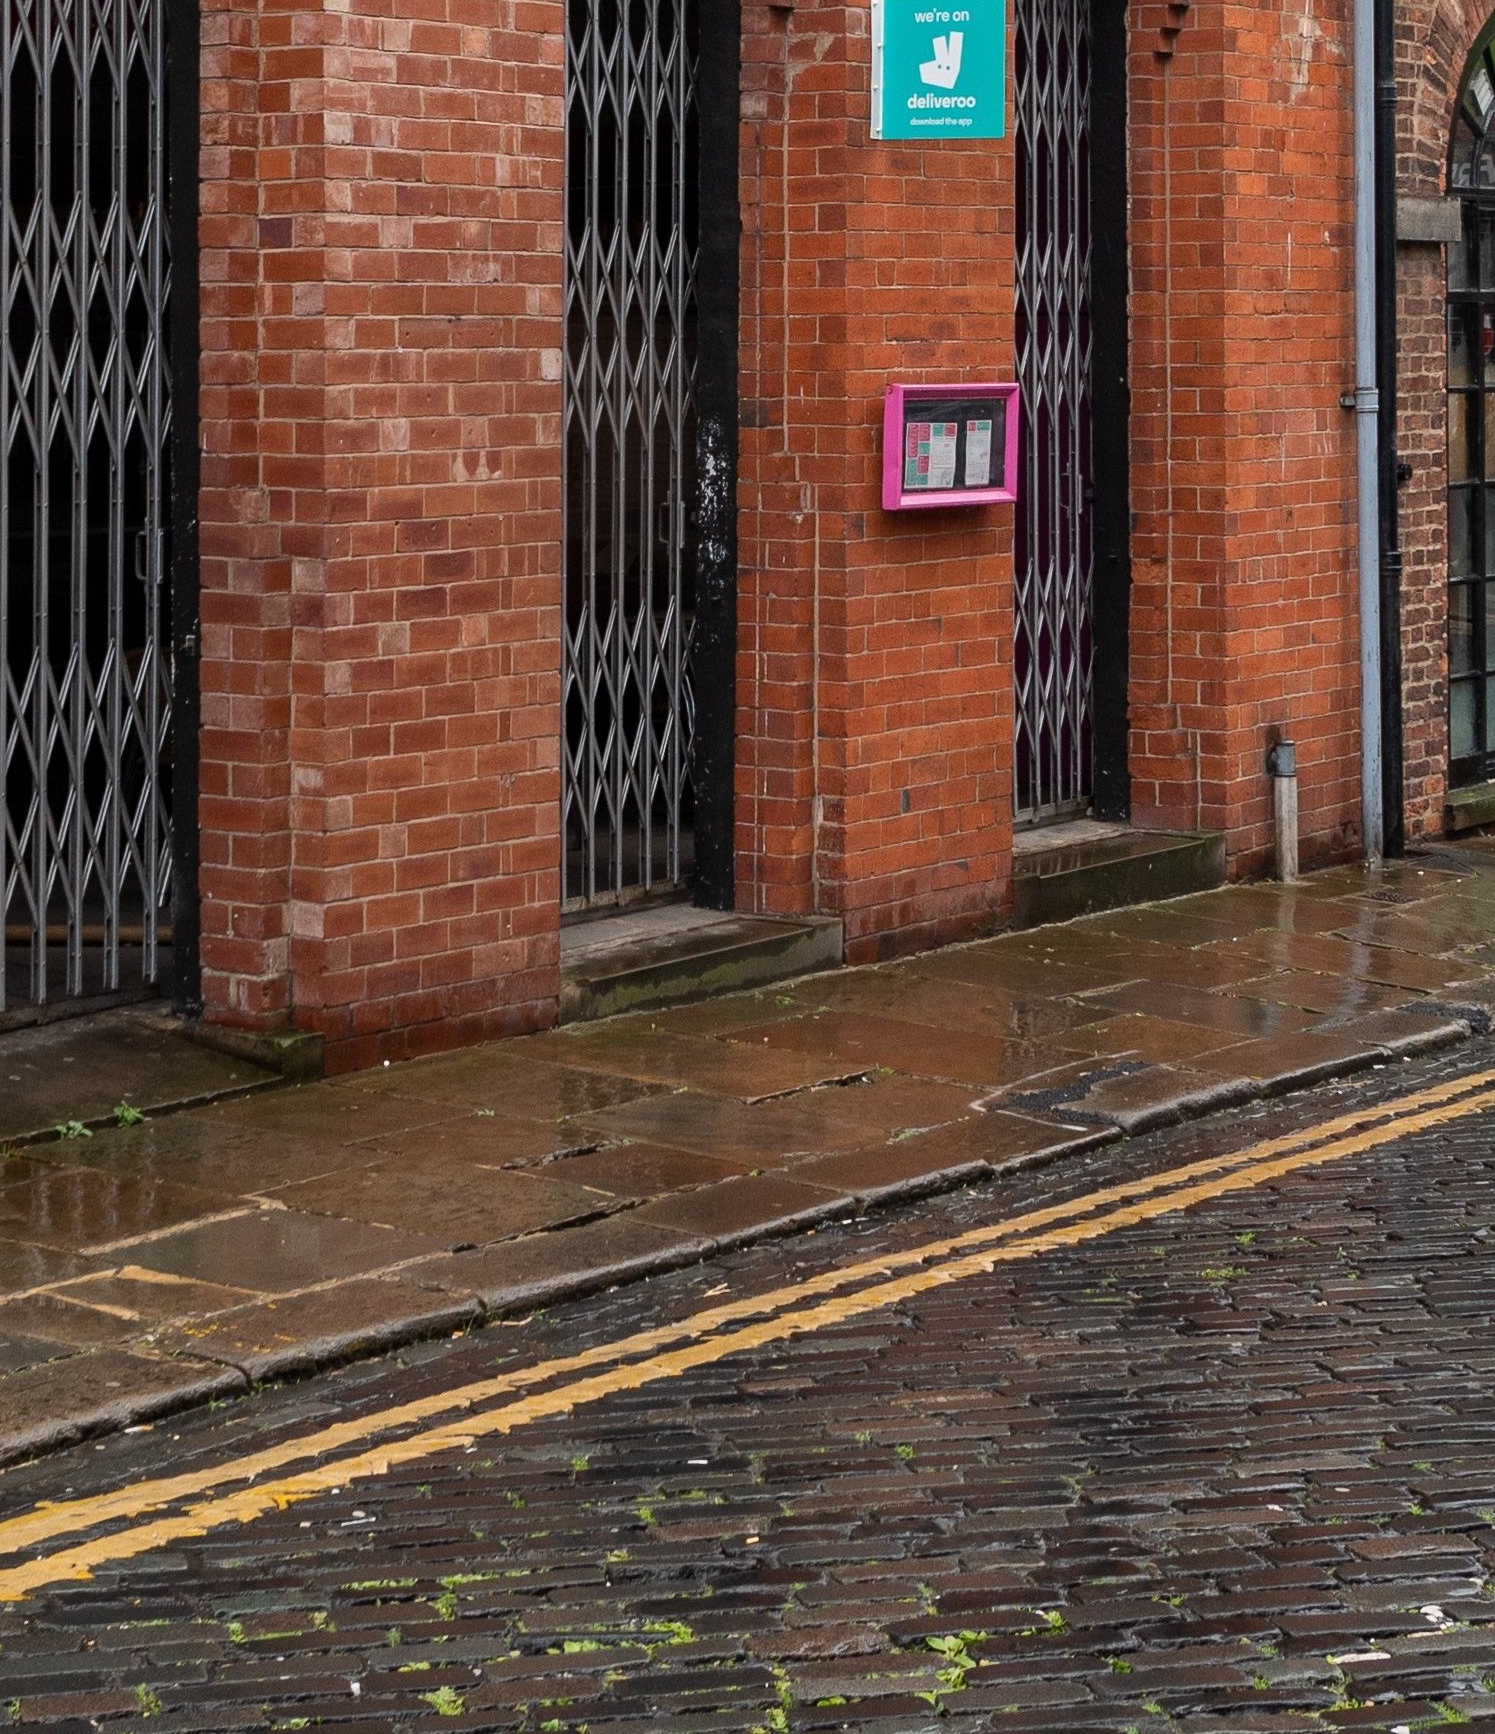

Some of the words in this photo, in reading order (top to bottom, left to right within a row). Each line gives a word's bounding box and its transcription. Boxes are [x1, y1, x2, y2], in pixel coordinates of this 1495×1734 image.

[914, 7, 950, 23] we're
[952, 10, 970, 22] on
[907, 92, 977, 109] deliveroo
[909, 116, 944, 126] download
[945, 116, 957, 126] the
[958, 118, 973, 127] app
